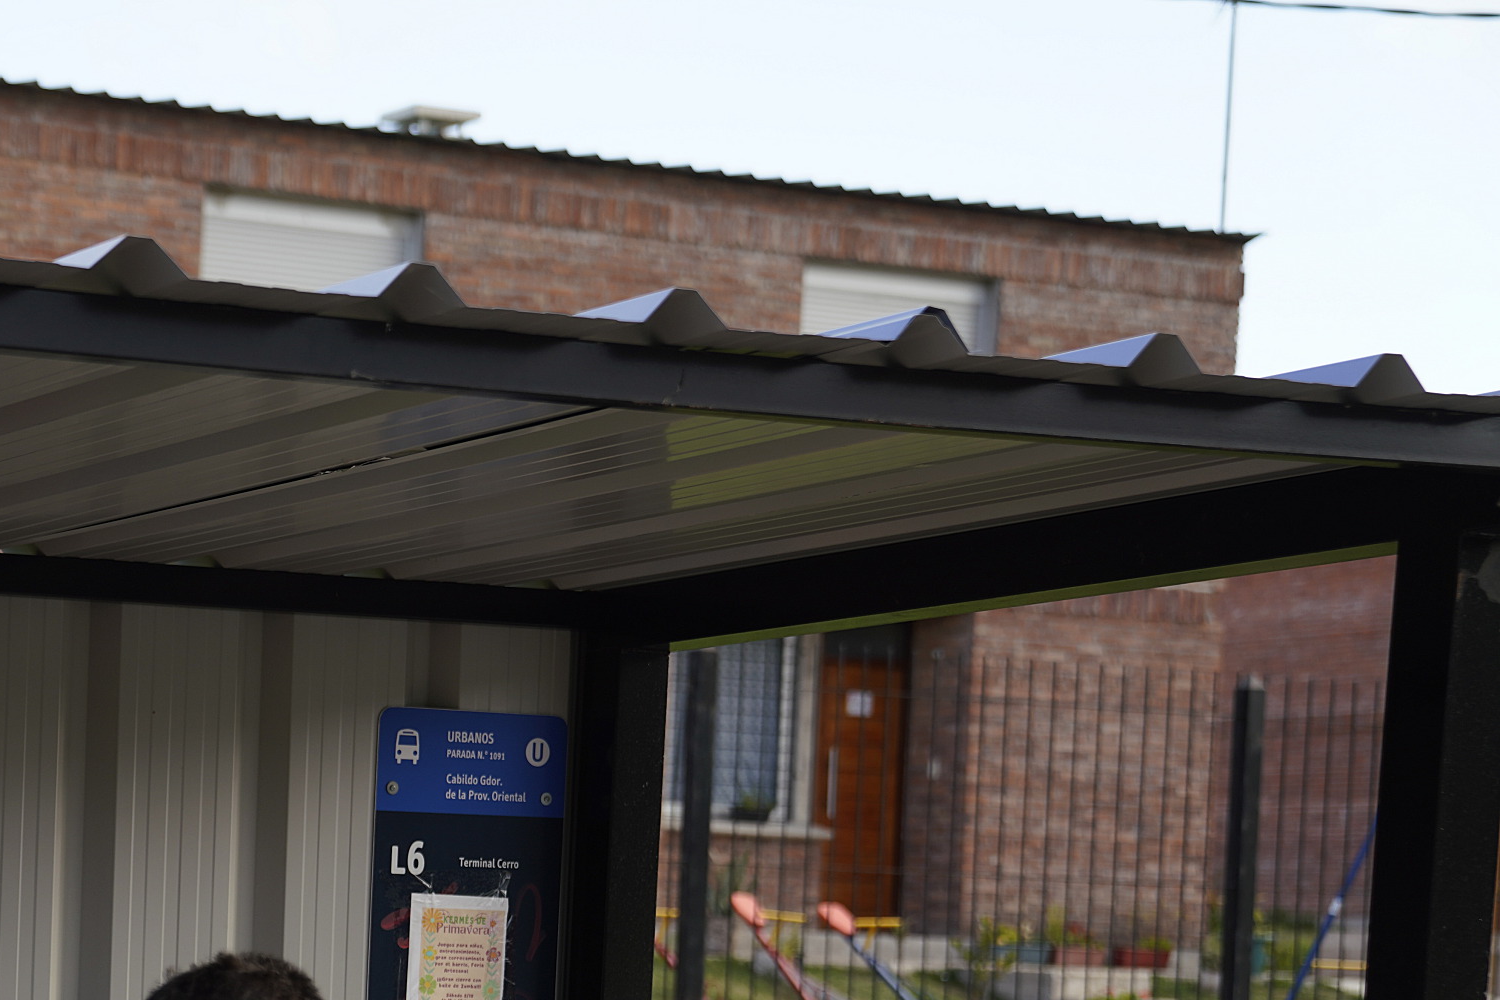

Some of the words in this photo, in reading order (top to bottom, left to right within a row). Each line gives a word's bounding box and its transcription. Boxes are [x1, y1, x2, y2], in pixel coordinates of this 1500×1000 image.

[447, 730, 494, 745] URBANOS
[446, 749, 476, 760] PARADA
[490, 751, 505, 761] 1091
[532, 741, 544, 763] U
[446, 773, 478, 785] Cabildo
[480, 775, 503, 786] Gdor.
[445, 789, 456, 800] de
[458, 789, 466, 800] la
[468, 790, 490, 802] Prov.
[491, 791, 526, 803] Oriental
[390, 840, 425, 876] L6
[459, 857, 495, 869] Terminal
[497, 858, 519, 869] Cerro
[443, 914, 474, 925] KERMÉS
[476, 916, 487, 925] DE
[436, 922, 490, 935] Primavera
